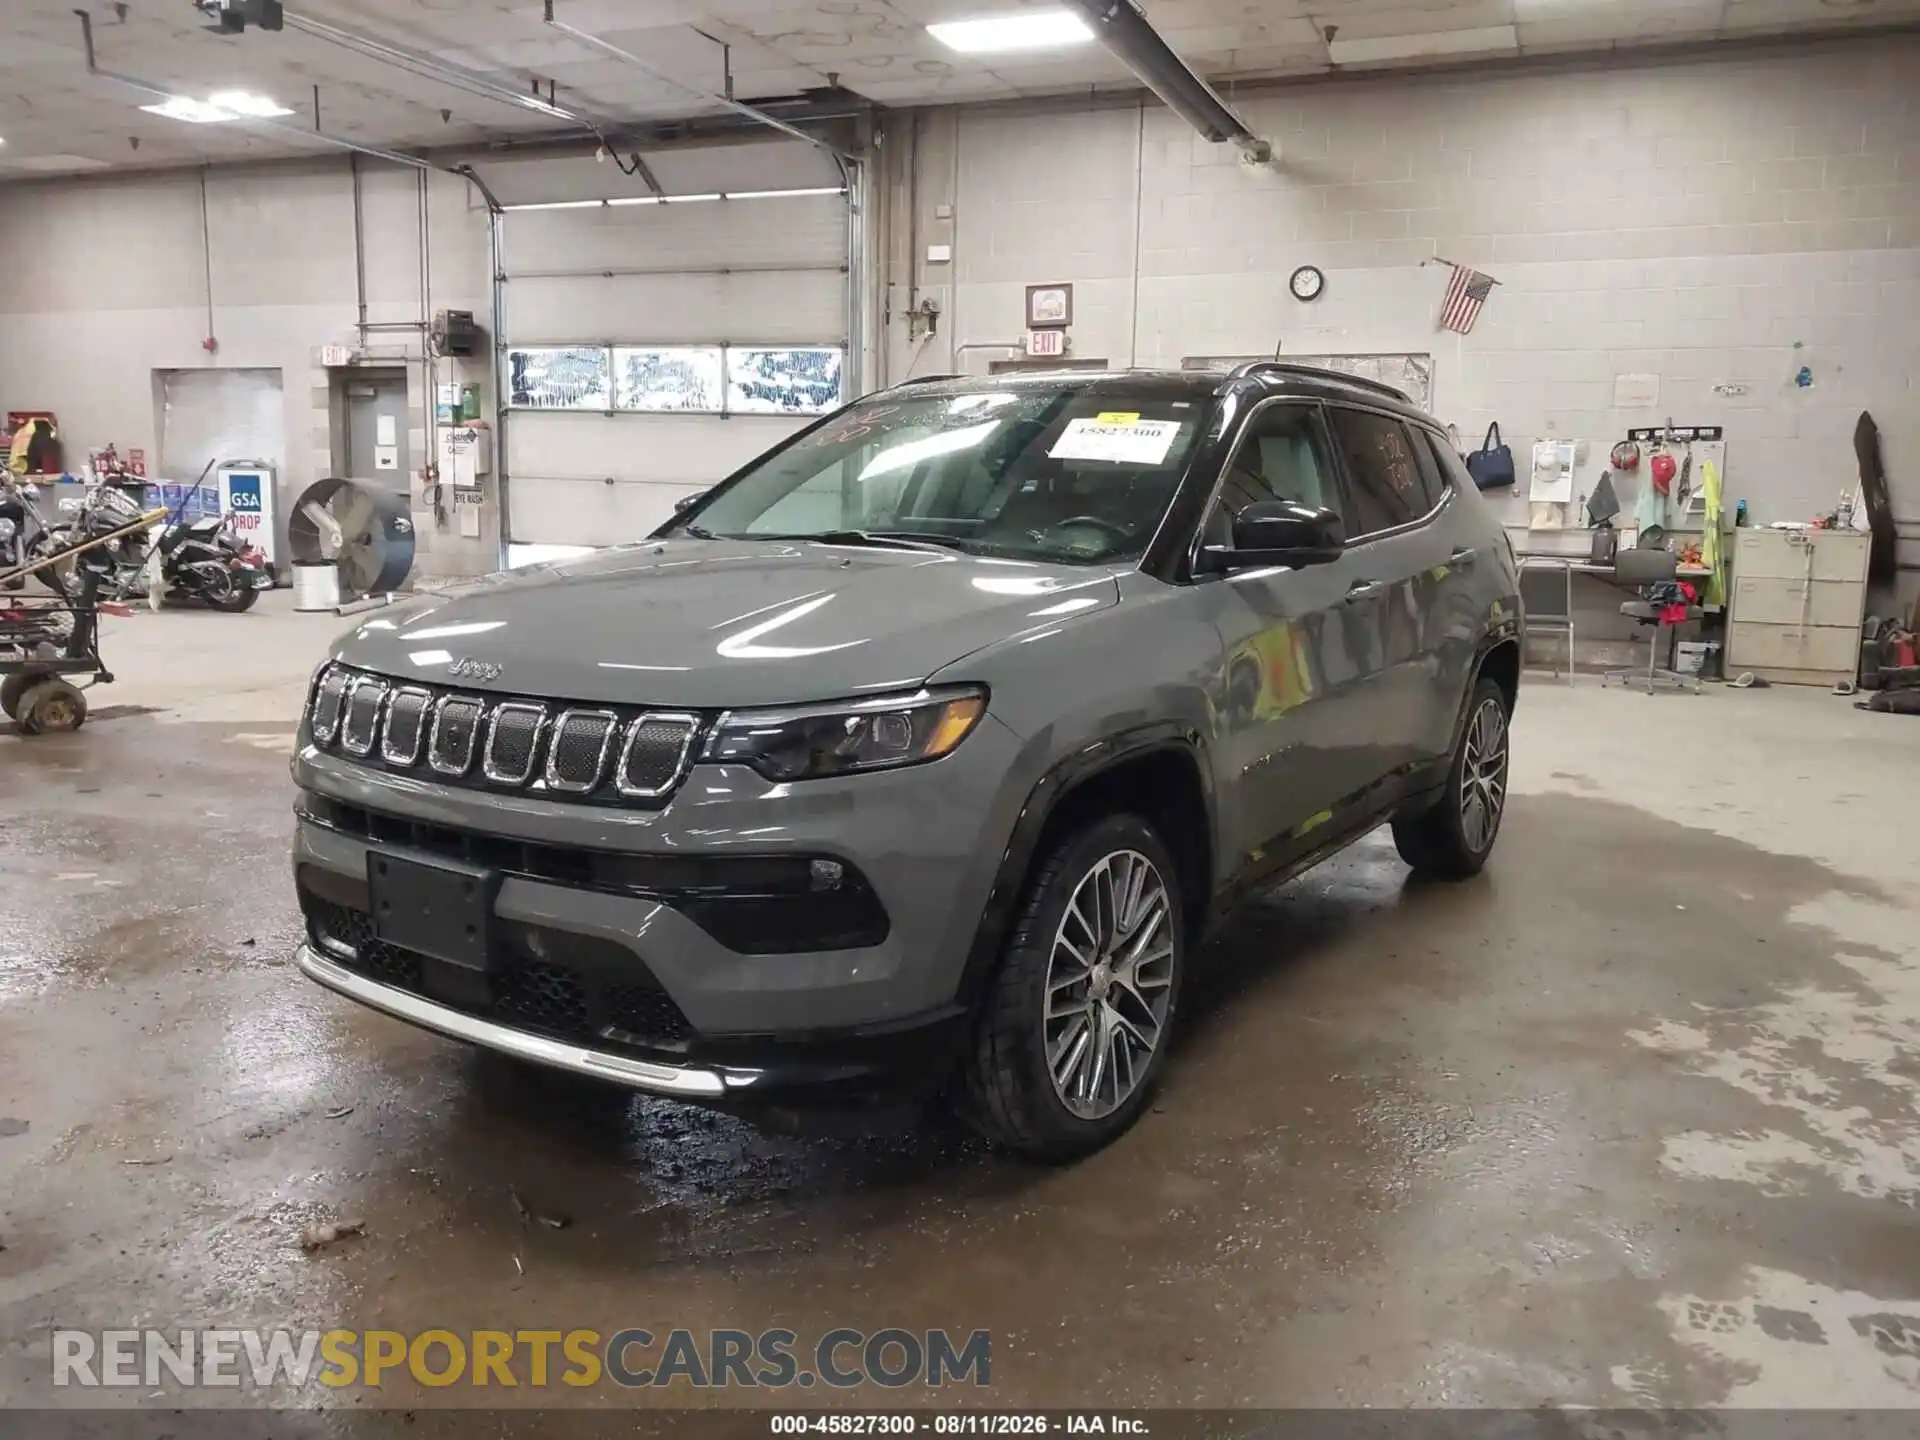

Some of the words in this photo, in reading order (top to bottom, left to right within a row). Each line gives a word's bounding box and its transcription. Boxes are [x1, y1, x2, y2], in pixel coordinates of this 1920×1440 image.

[1033, 332, 1057, 353] EXIT
[231, 492, 260, 506] GSA
[233, 514, 260, 529] DROP
